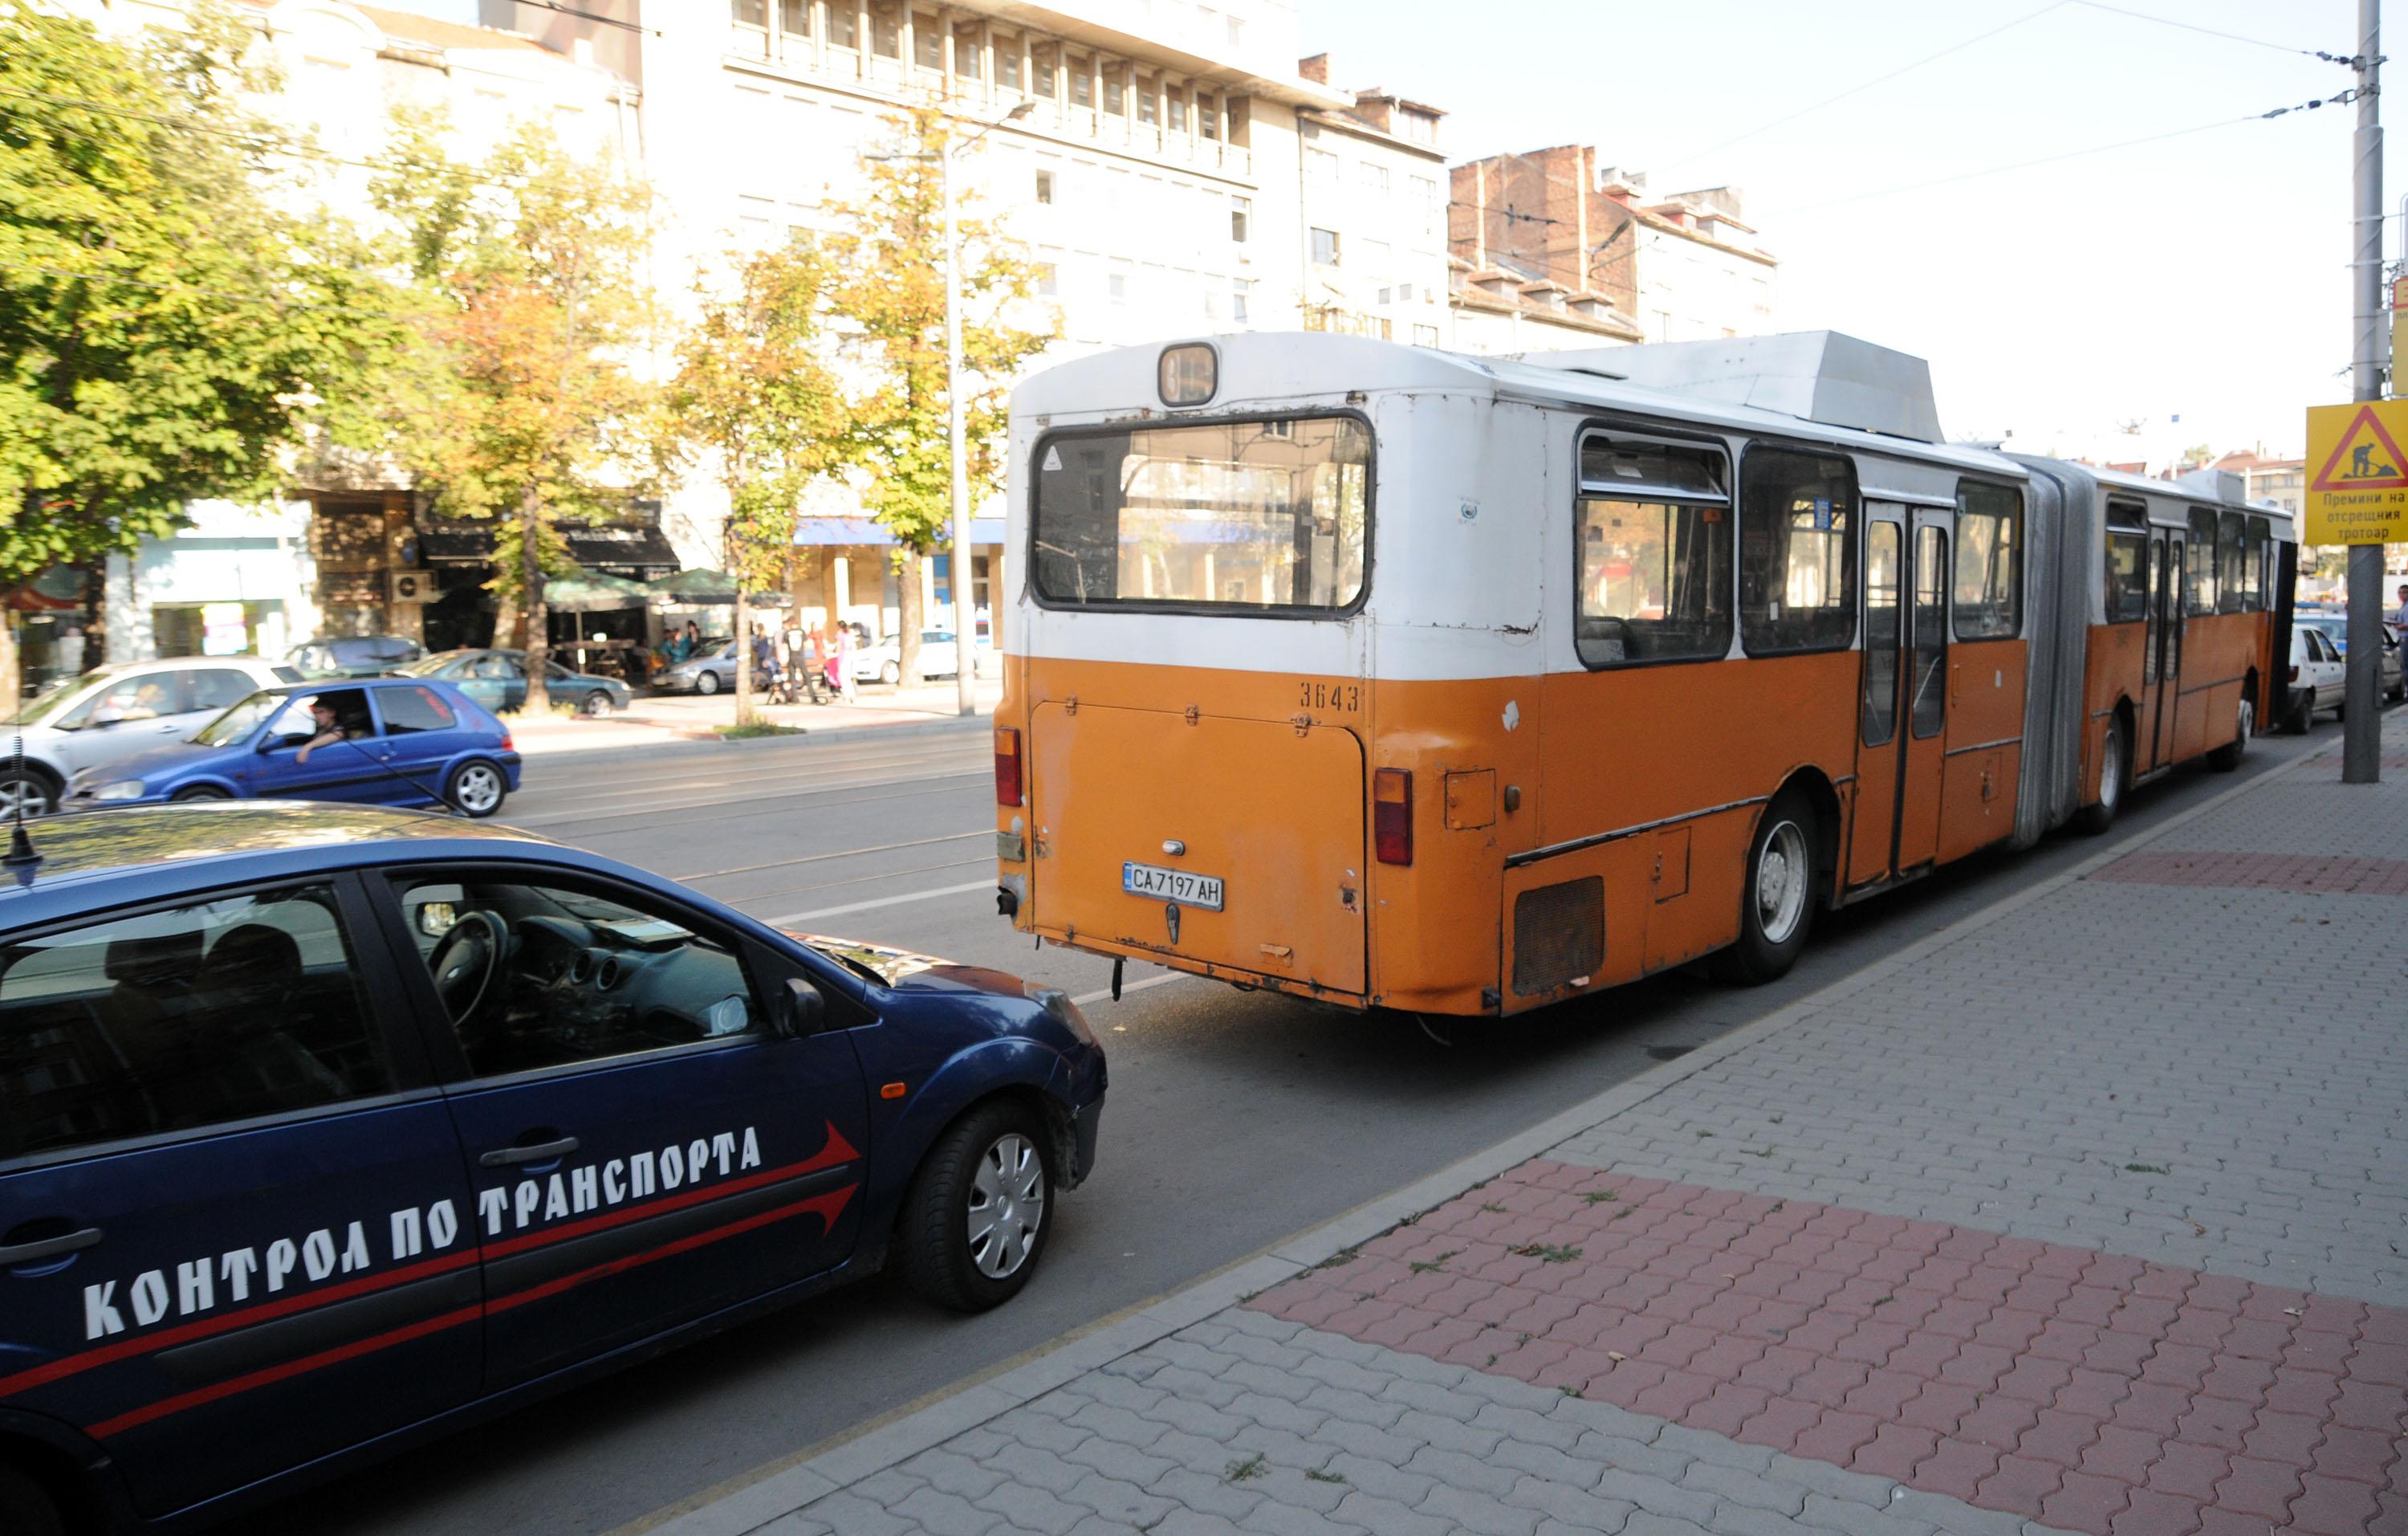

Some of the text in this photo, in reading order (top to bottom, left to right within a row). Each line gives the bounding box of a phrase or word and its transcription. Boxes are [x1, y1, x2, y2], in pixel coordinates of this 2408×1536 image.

[2324, 493, 2405, 508] Премини на
[2328, 511, 2400, 524] отсрещния
[2338, 528, 2389, 541] тротоар
[1300, 682, 1358, 711] 3643
[84, 1127, 762, 1341] КОНТРОЛ ПО ТРАНСПОРТА
